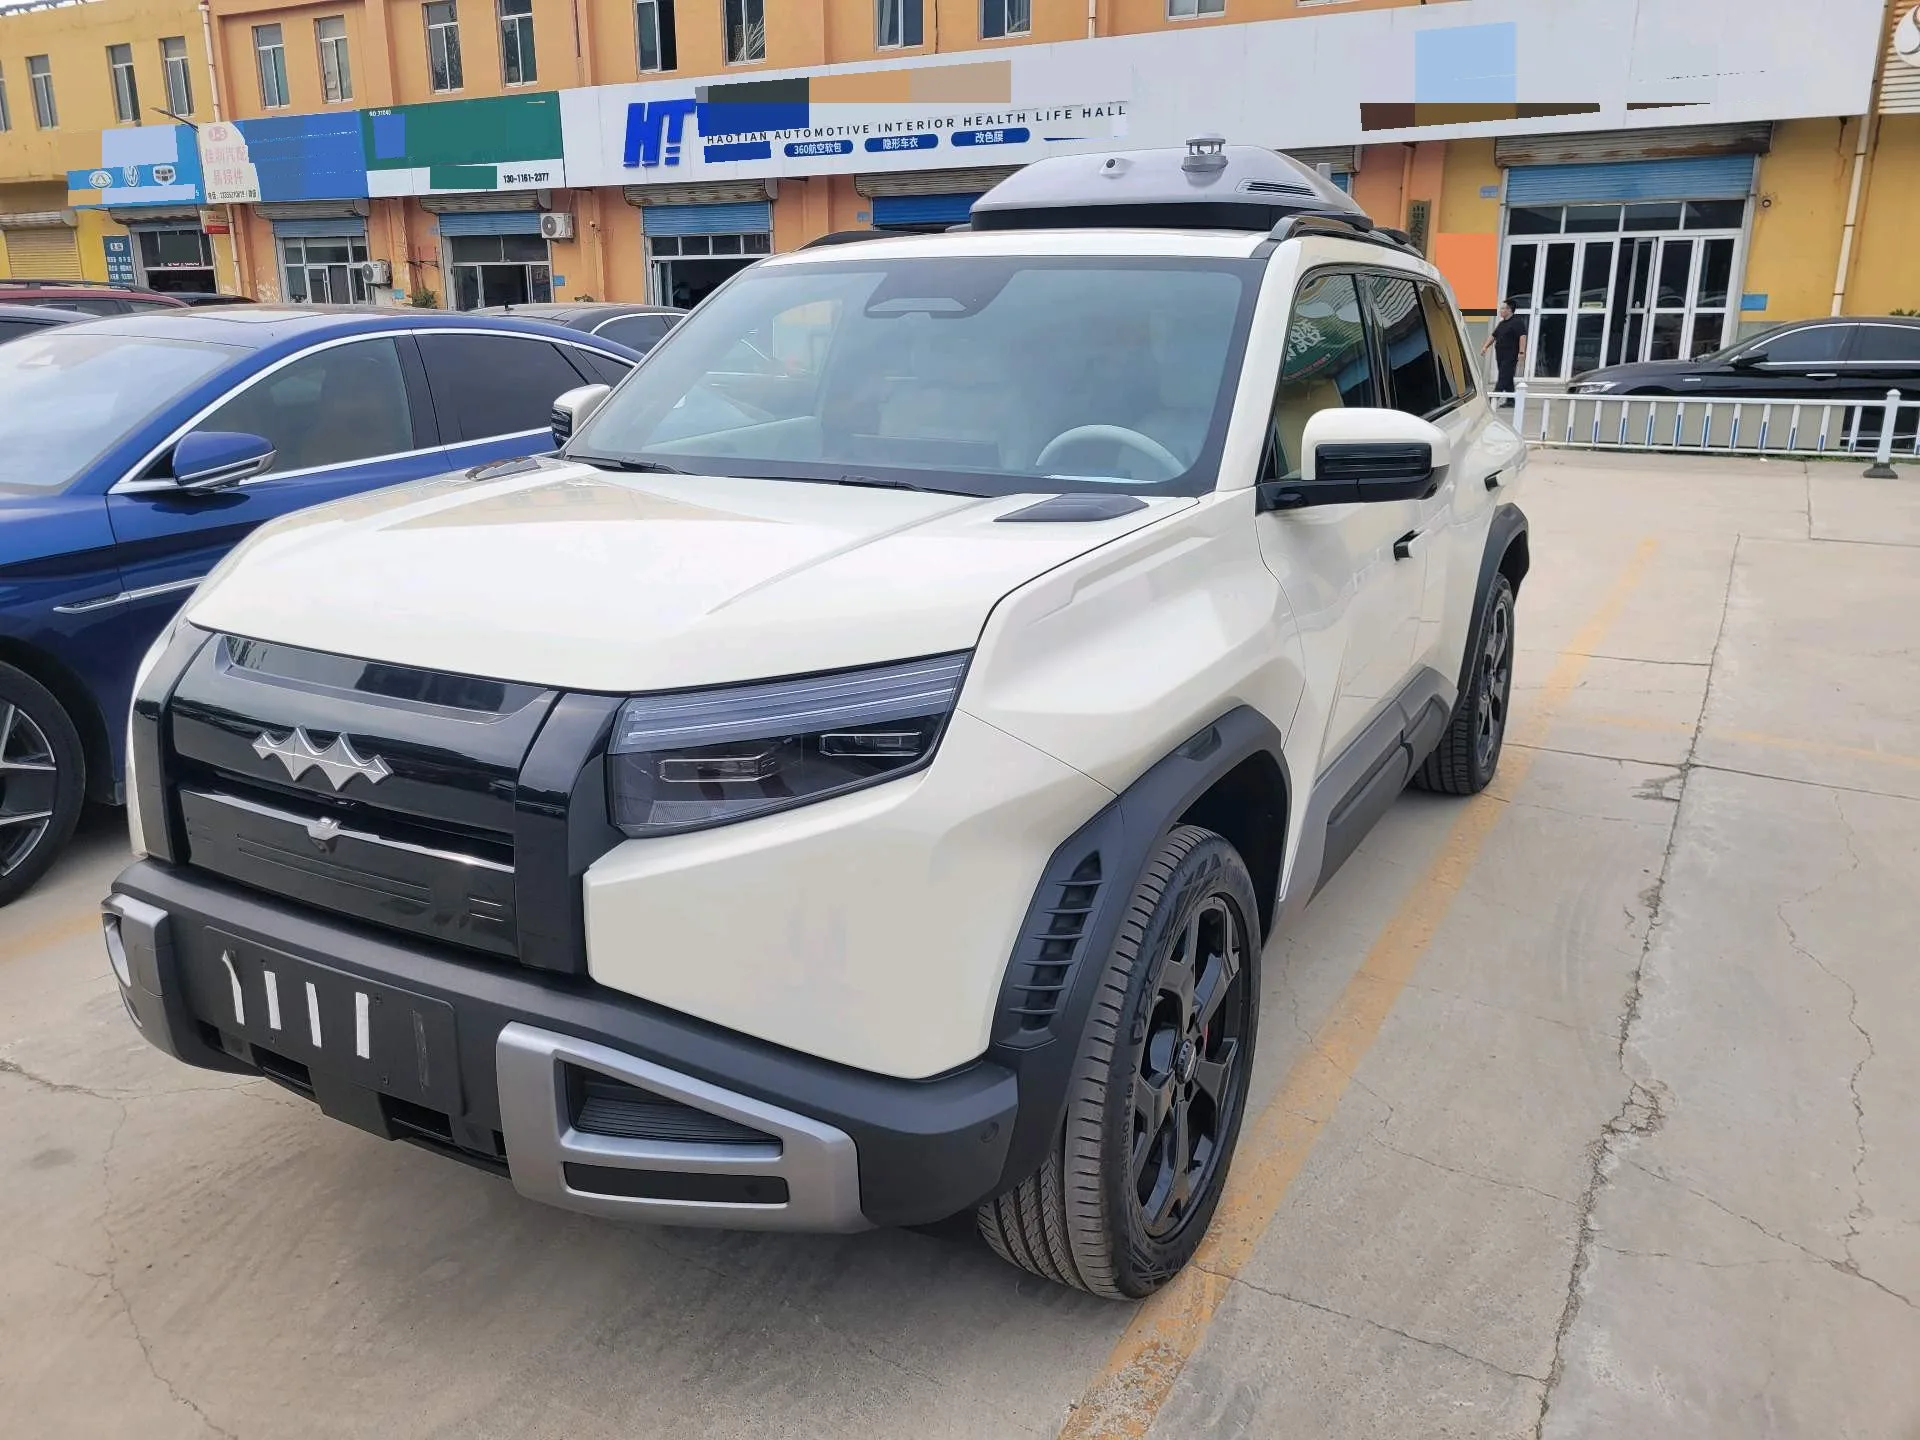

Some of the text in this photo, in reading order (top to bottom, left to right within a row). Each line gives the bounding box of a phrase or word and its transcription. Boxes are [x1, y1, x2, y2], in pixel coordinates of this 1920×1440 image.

[707, 104, 1127, 144] HAOTIAN AUTOMOTIVE INTERIOR HEALTH LIFE HALL
[975, 131, 1004, 143] 改色膜
[794, 142, 842, 154] 360航空软包
[882, 137, 919, 150] 隐形车衣
[503, 172, 549, 183] 130-1161-2377
